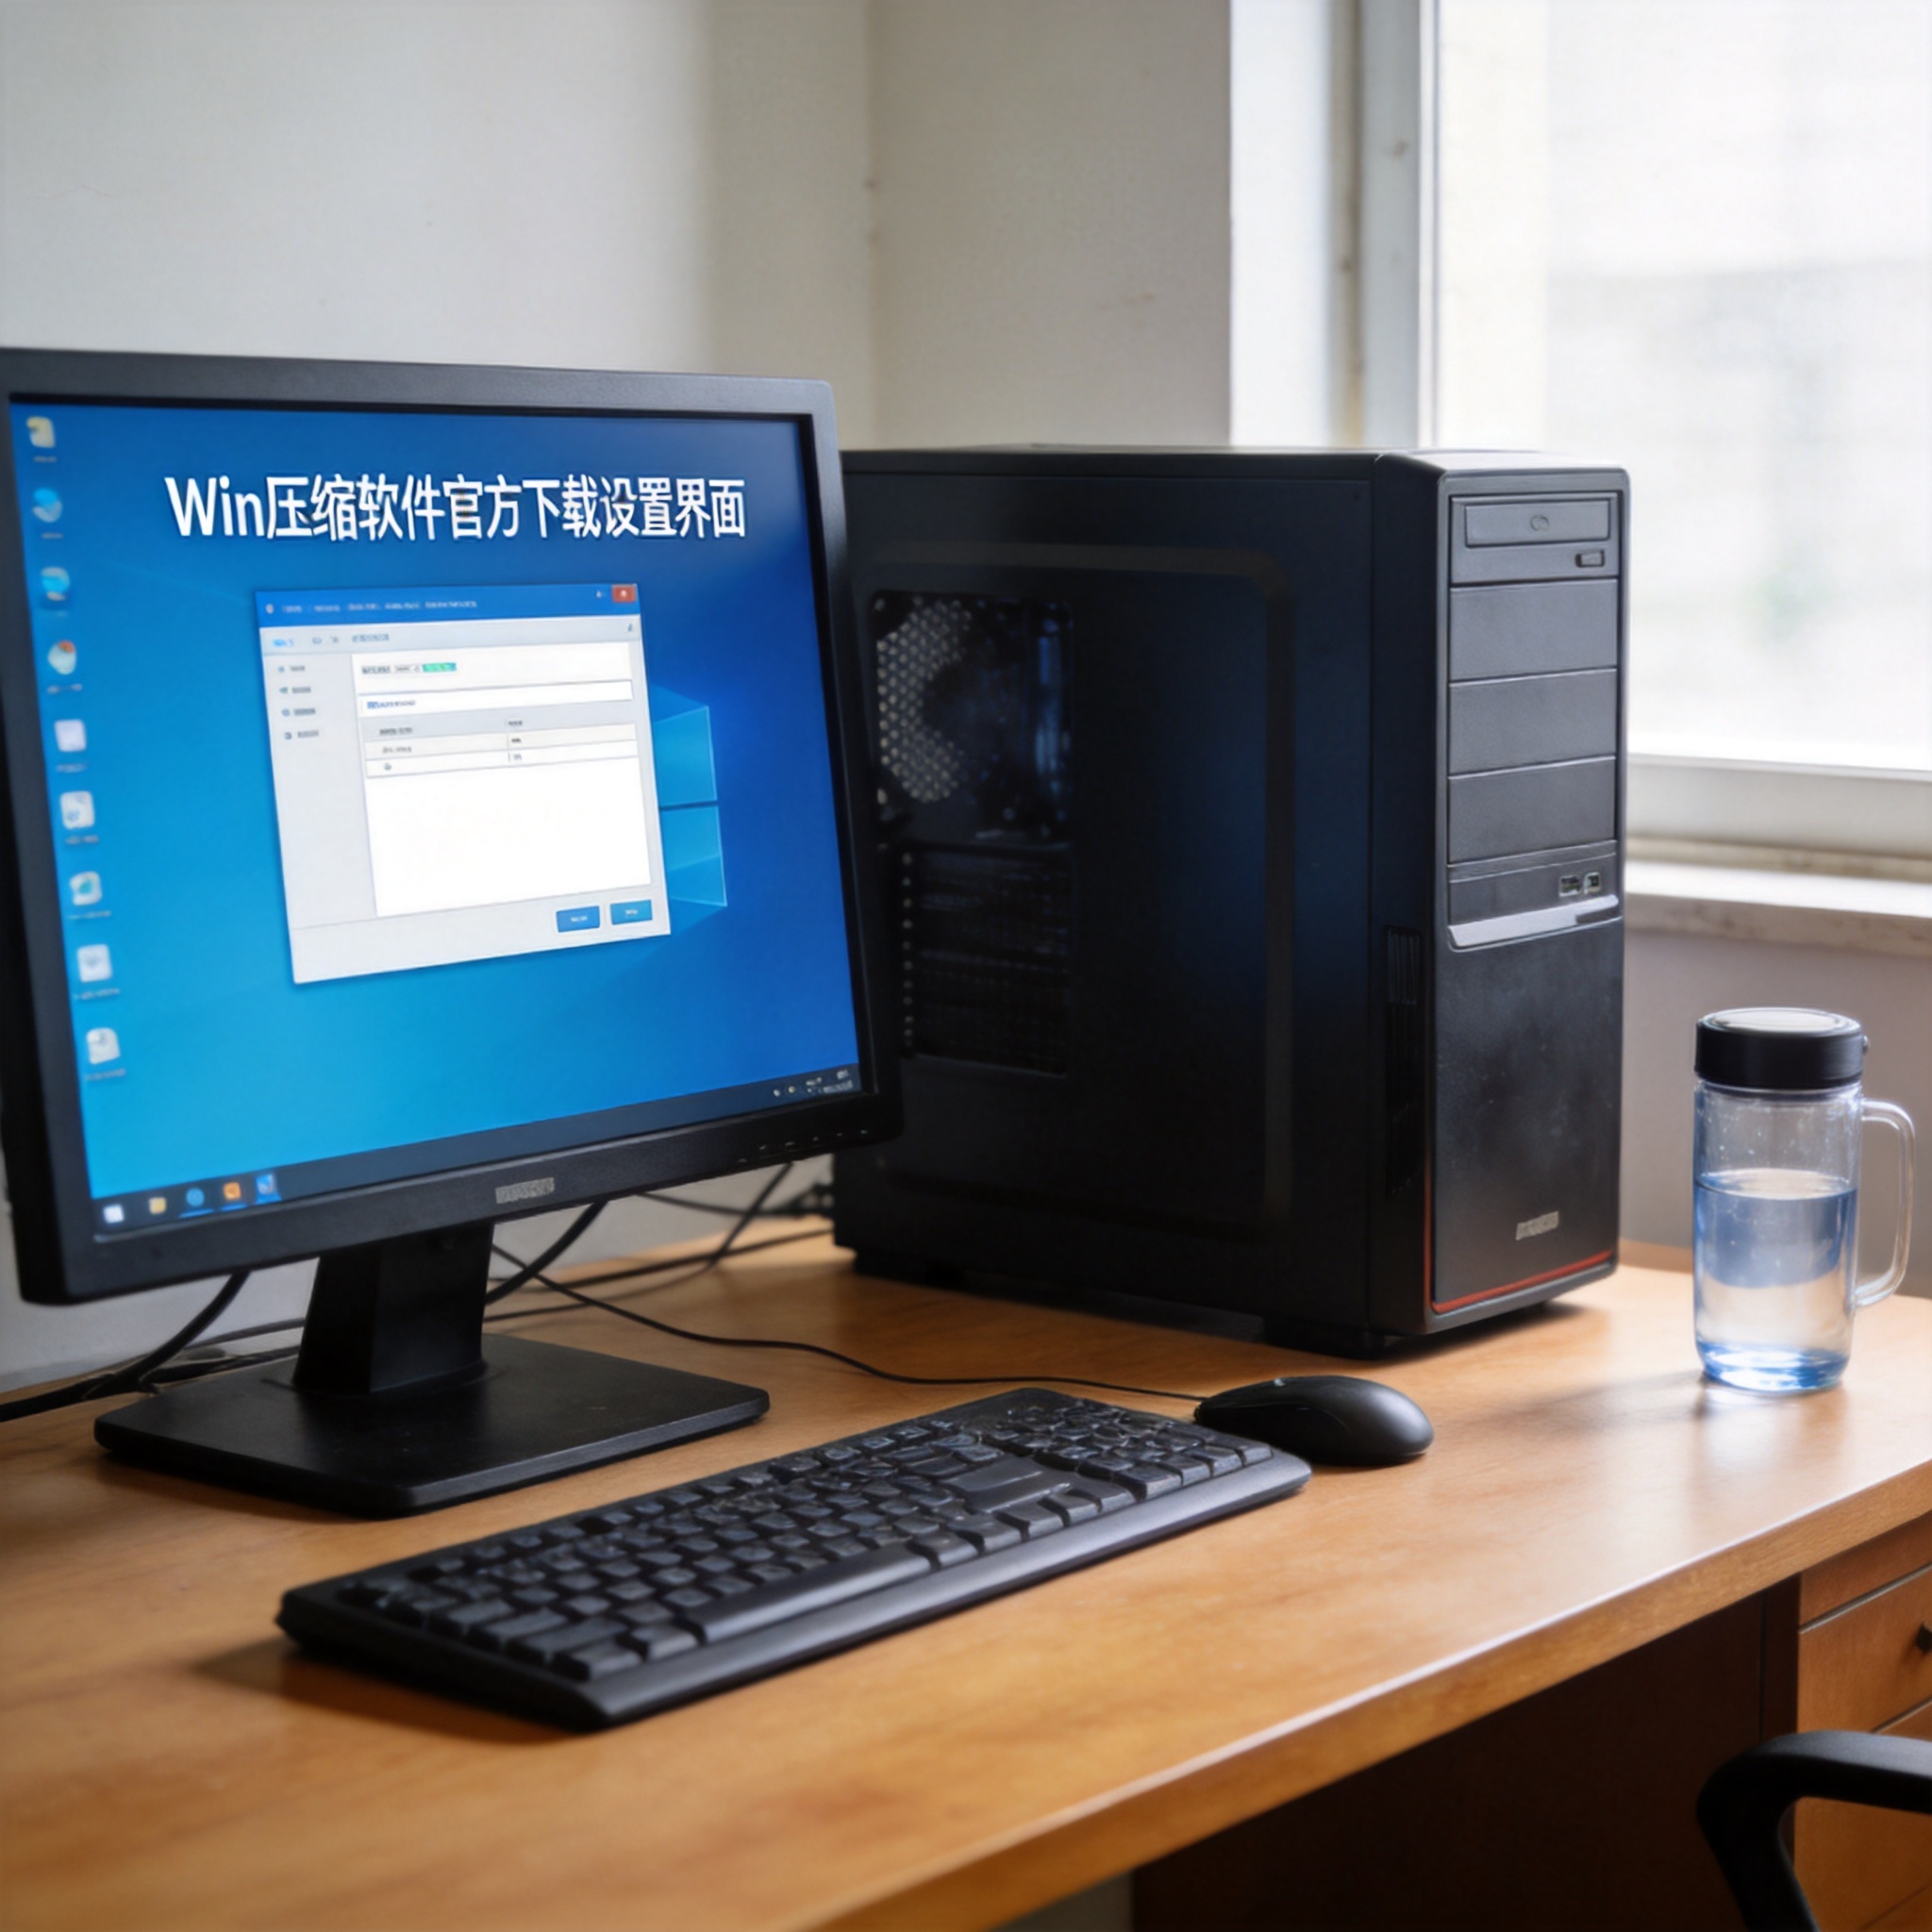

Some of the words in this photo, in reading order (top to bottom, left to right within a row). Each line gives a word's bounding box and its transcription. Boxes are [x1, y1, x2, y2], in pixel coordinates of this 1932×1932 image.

[164, 474, 746, 541] Win压缩软件官方下载设置界面
